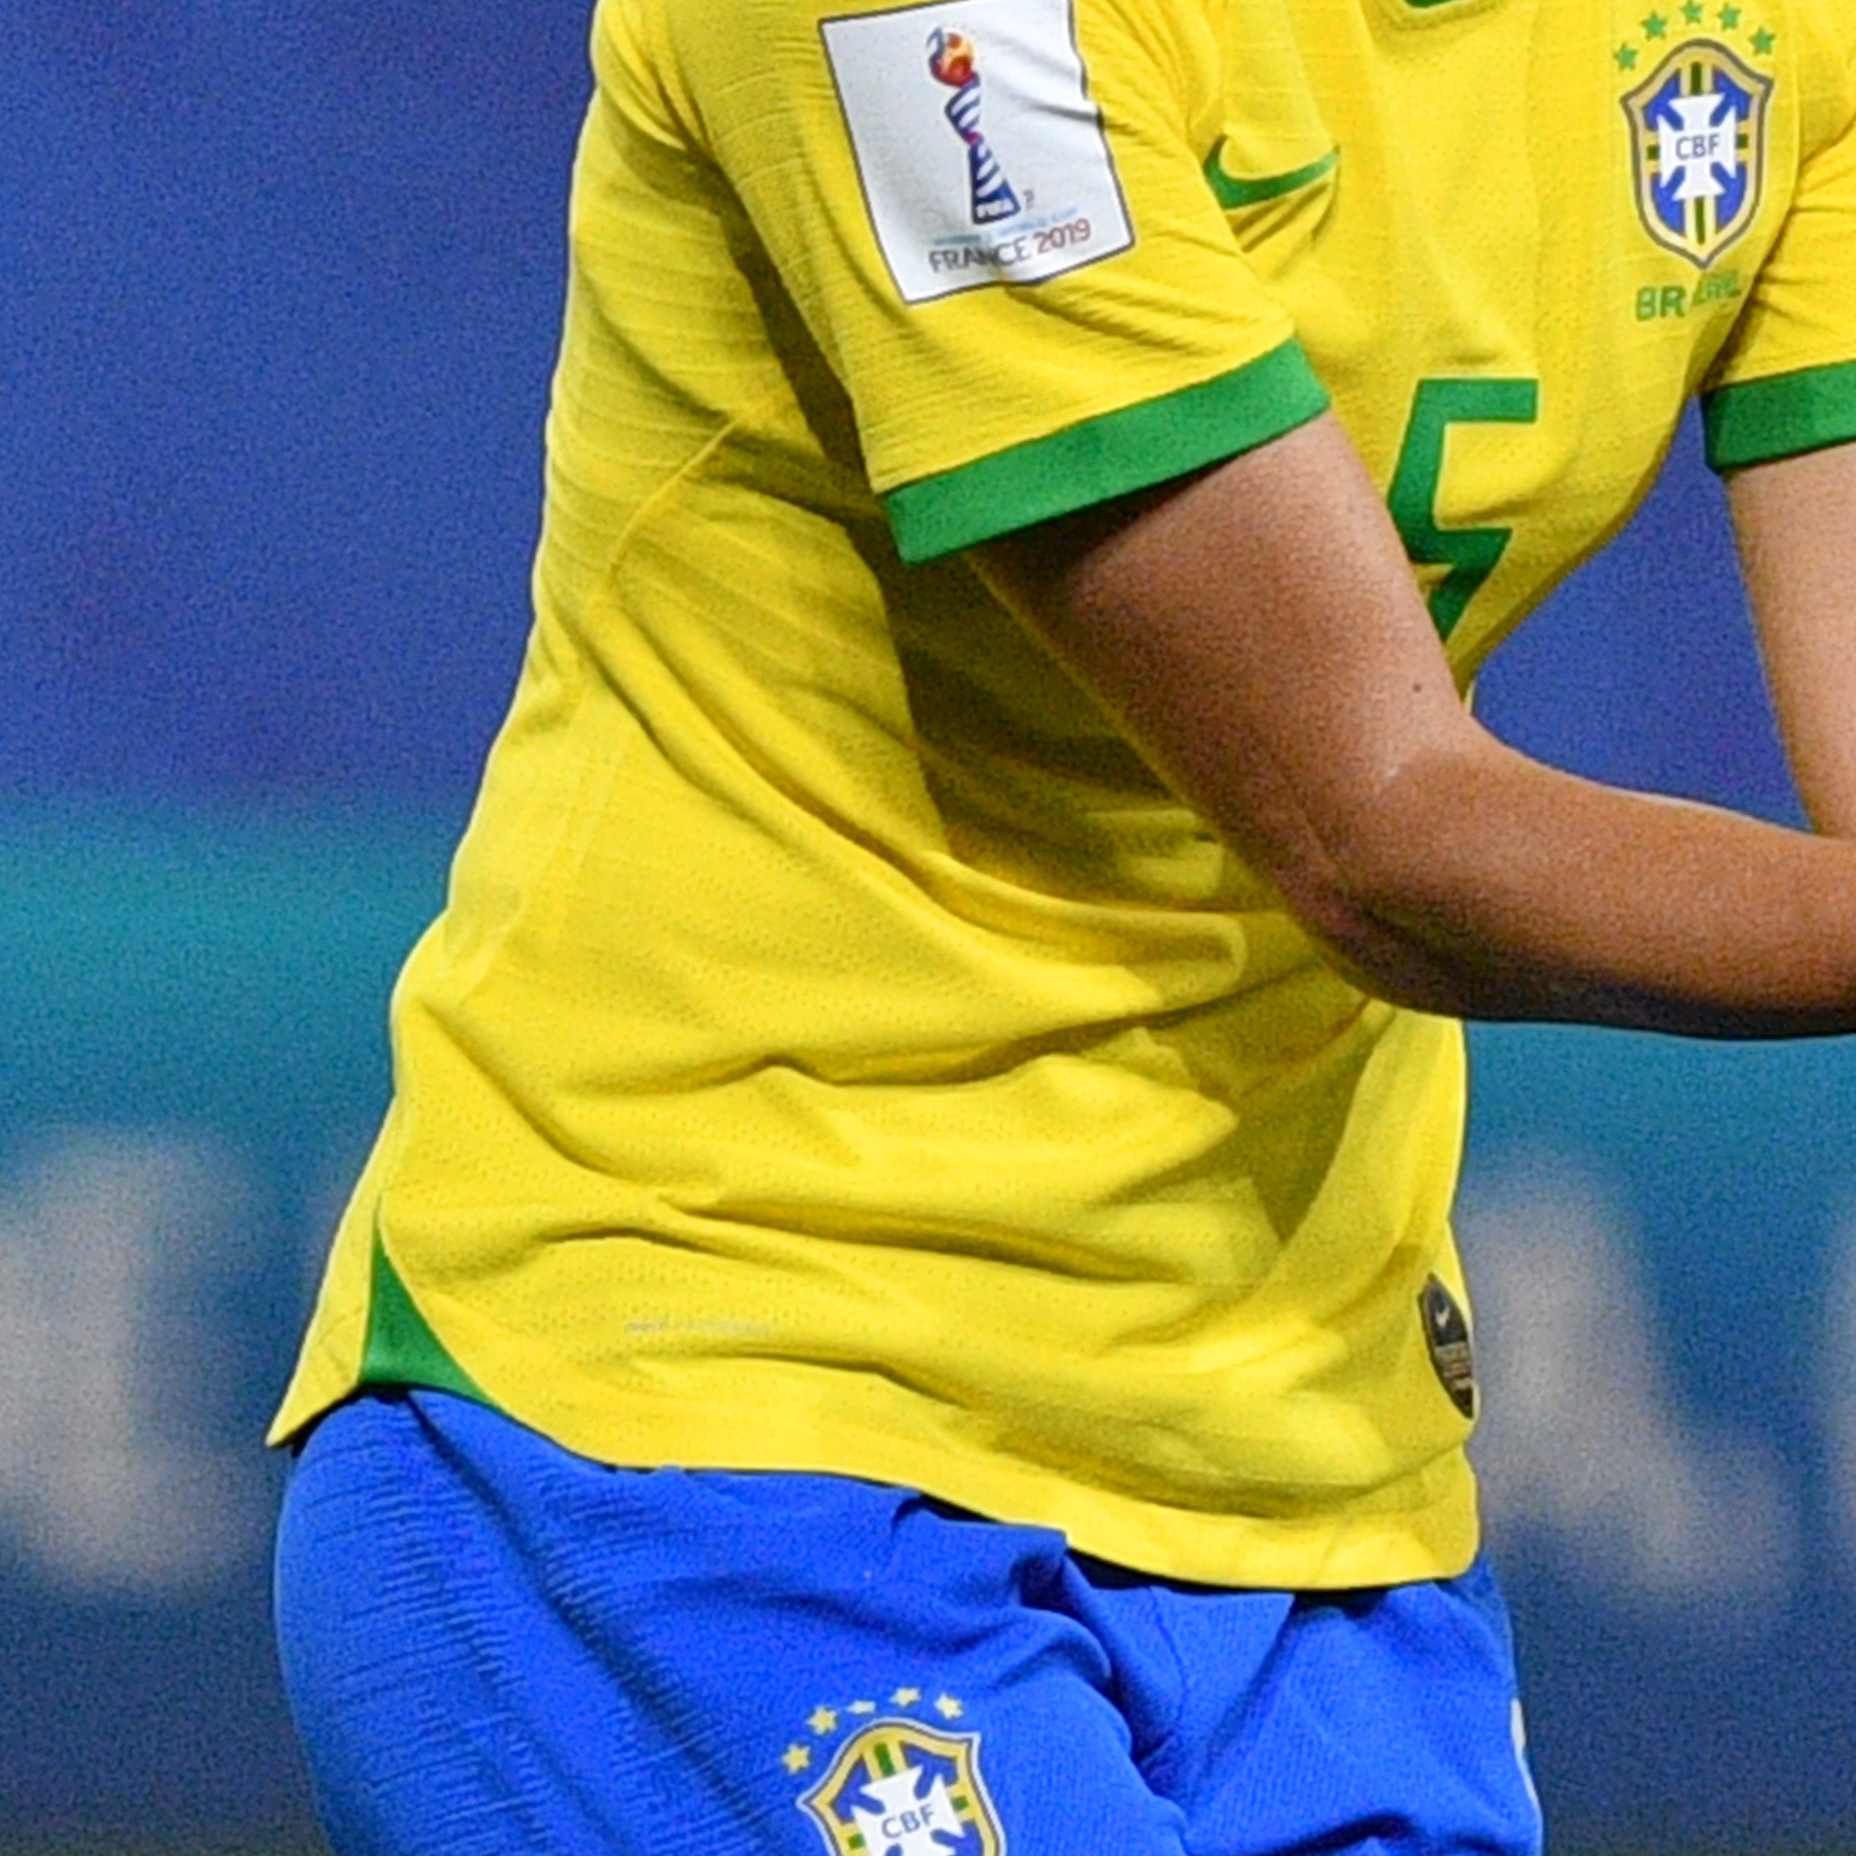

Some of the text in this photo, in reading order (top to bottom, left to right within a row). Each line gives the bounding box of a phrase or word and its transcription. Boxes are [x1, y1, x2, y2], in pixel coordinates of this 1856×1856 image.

[1675, 133, 1721, 160] CBF
[929, 236, 1032, 272] FRANCE
[1033, 218, 1091, 254] 2019
[1387, 378, 1538, 642] 5
[881, 1803, 935, 1840] CBF
